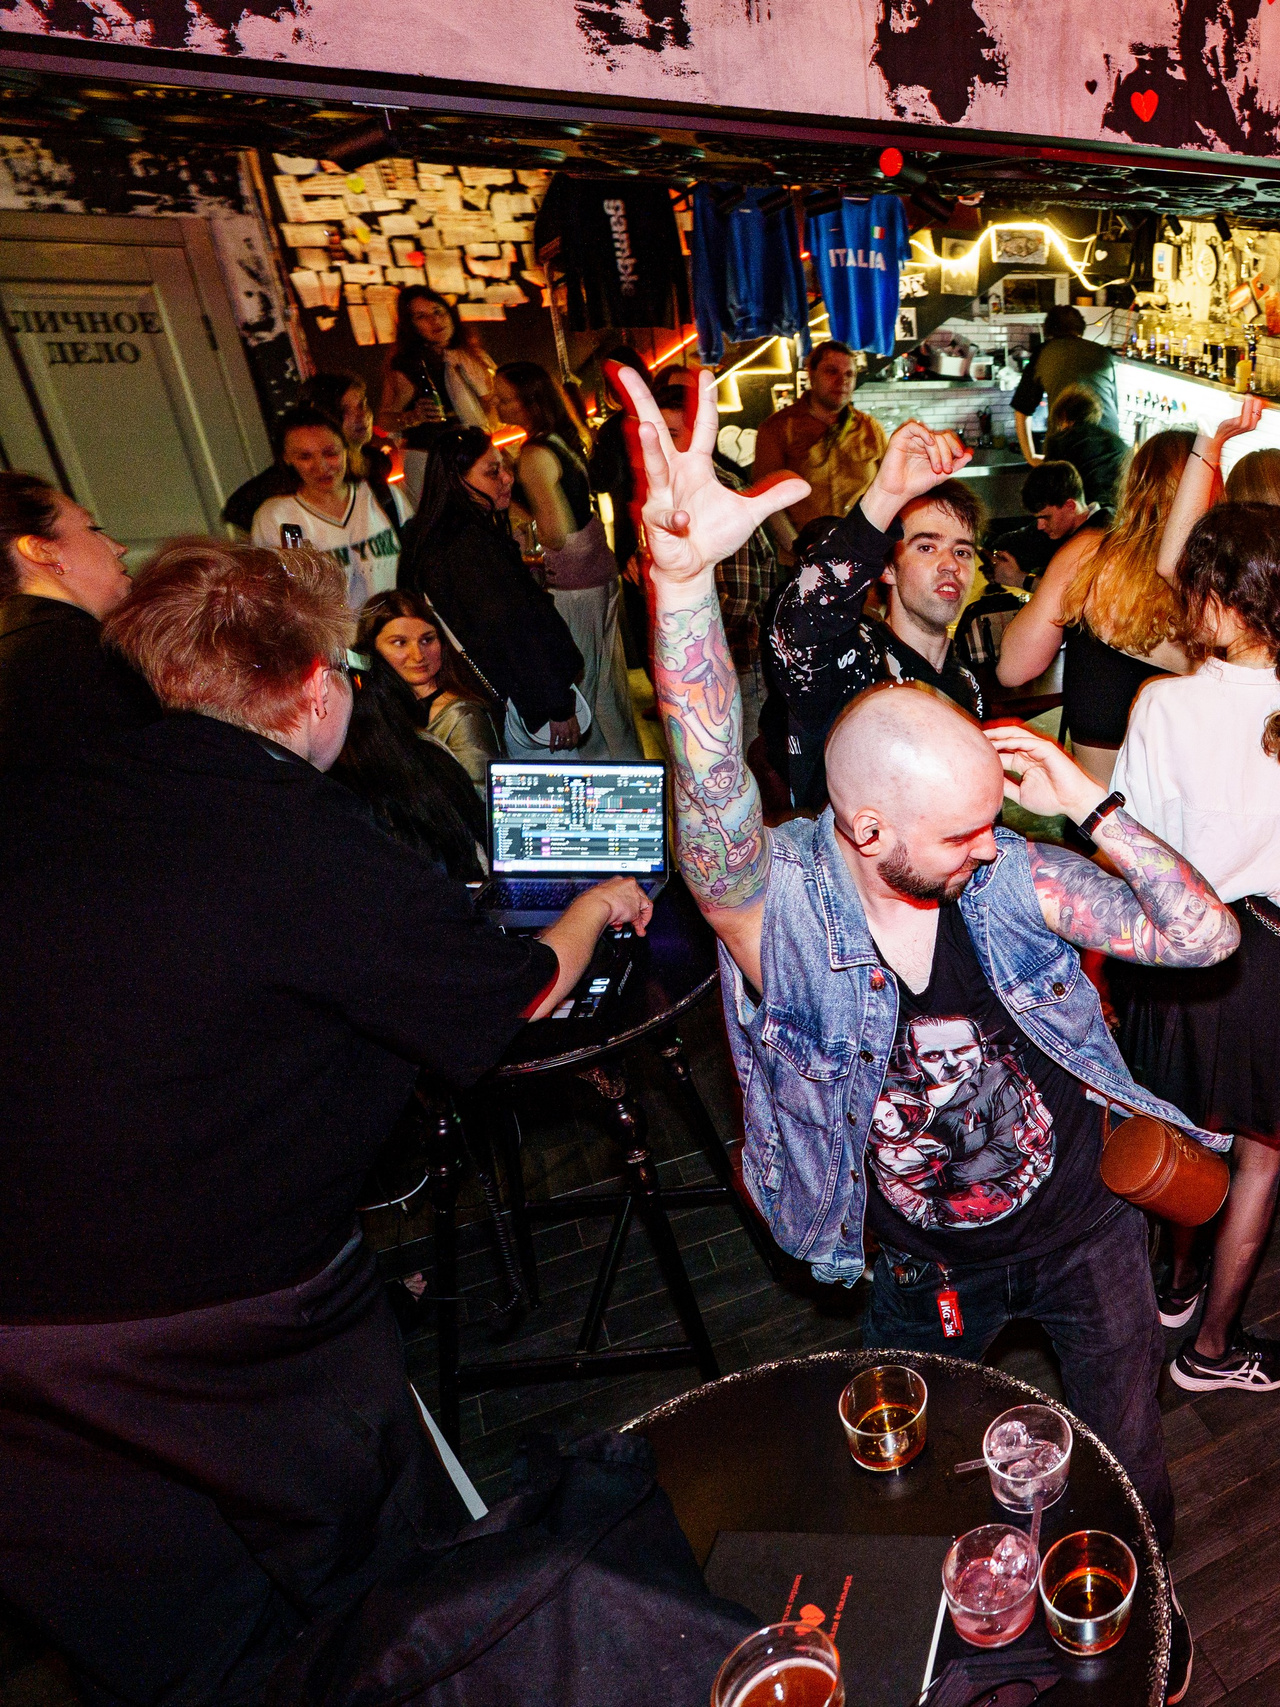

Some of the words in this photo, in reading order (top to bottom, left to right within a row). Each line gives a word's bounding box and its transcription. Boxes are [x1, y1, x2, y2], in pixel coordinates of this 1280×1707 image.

[828, 248, 887, 271] ITALIA
[9, 310, 165, 334] ЛИЧНОЕ
[47, 341, 141, 366] ДЕЛО
[940, 1305, 956, 1337] Koak
